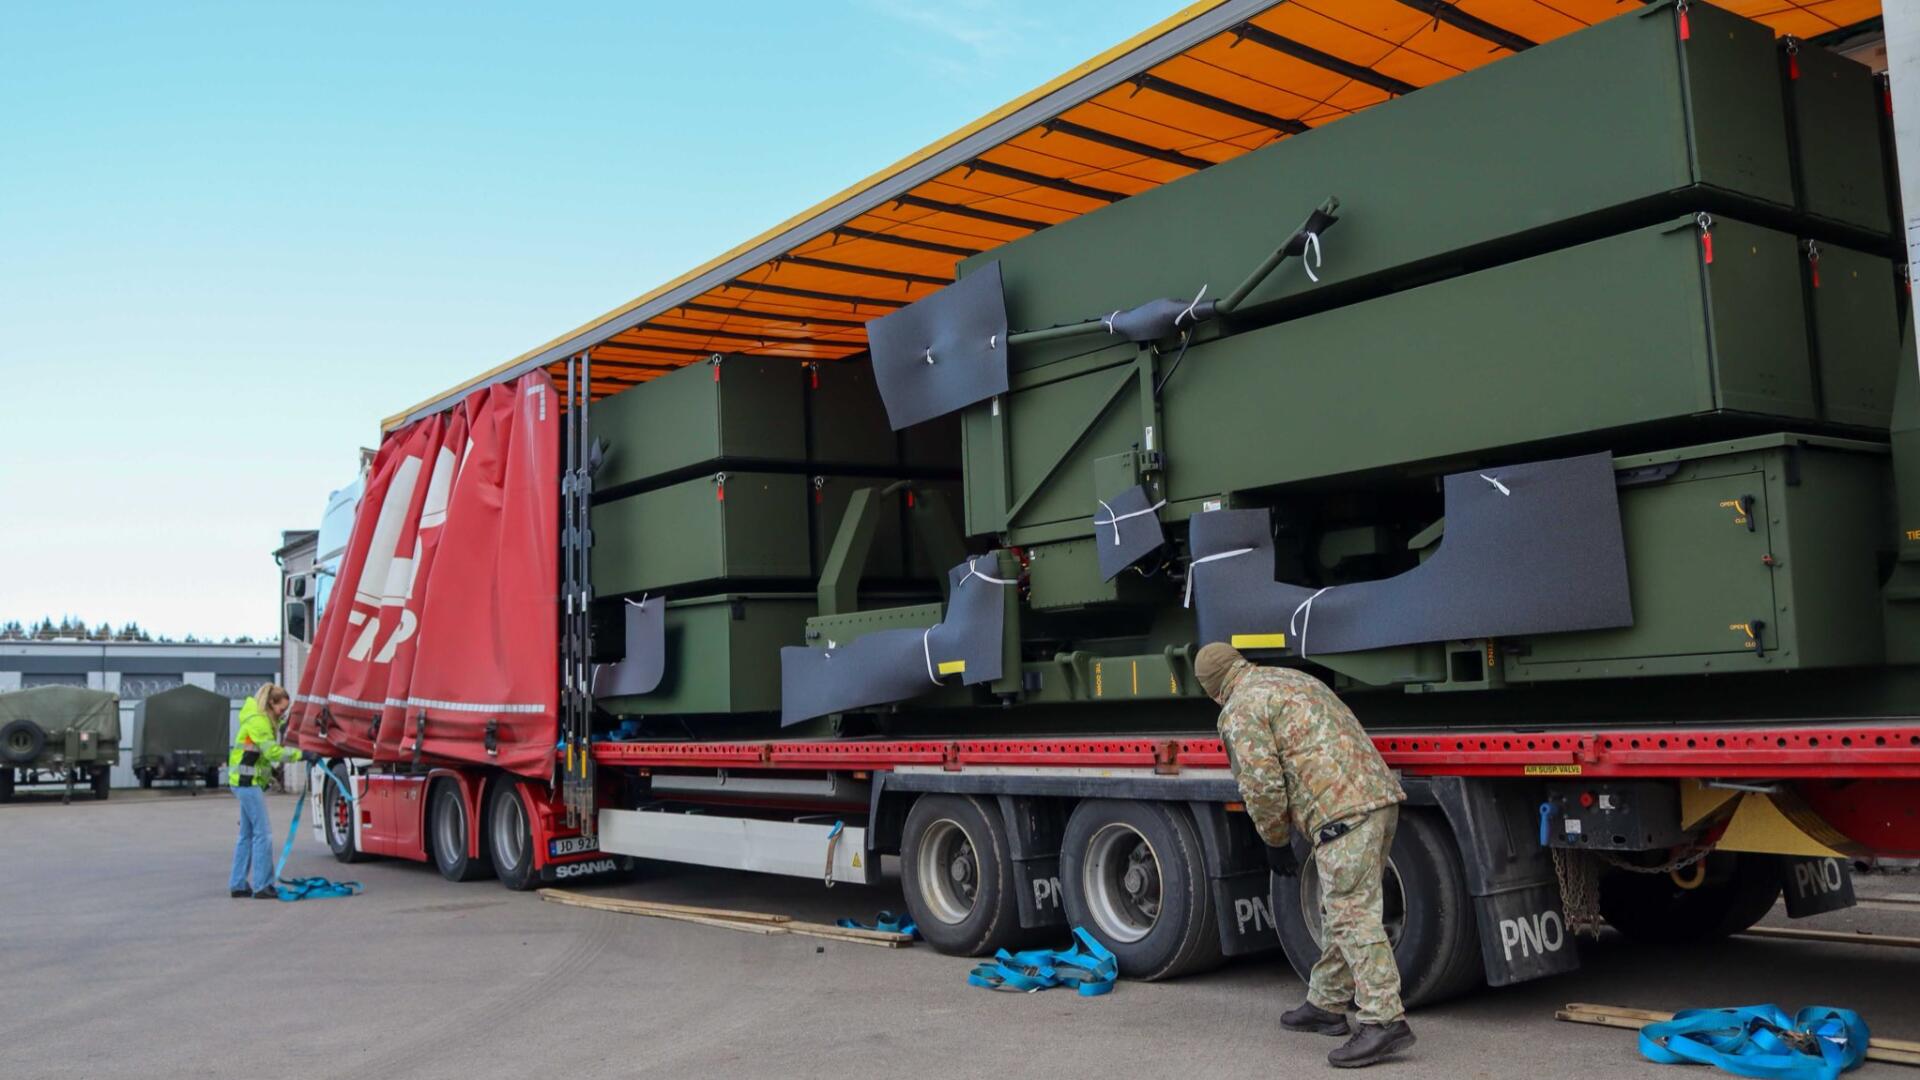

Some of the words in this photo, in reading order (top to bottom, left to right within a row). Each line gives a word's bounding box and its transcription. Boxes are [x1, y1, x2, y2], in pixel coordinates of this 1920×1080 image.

[1559, 765, 1580, 773] VALVE
[560, 841, 574, 853] JD
[556, 859, 617, 879] SCANIA
[1795, 857, 1842, 899] PNO
[1032, 877, 1062, 911] PN
[1234, 893, 1276, 935] PN
[1499, 909, 1564, 961] PNO
